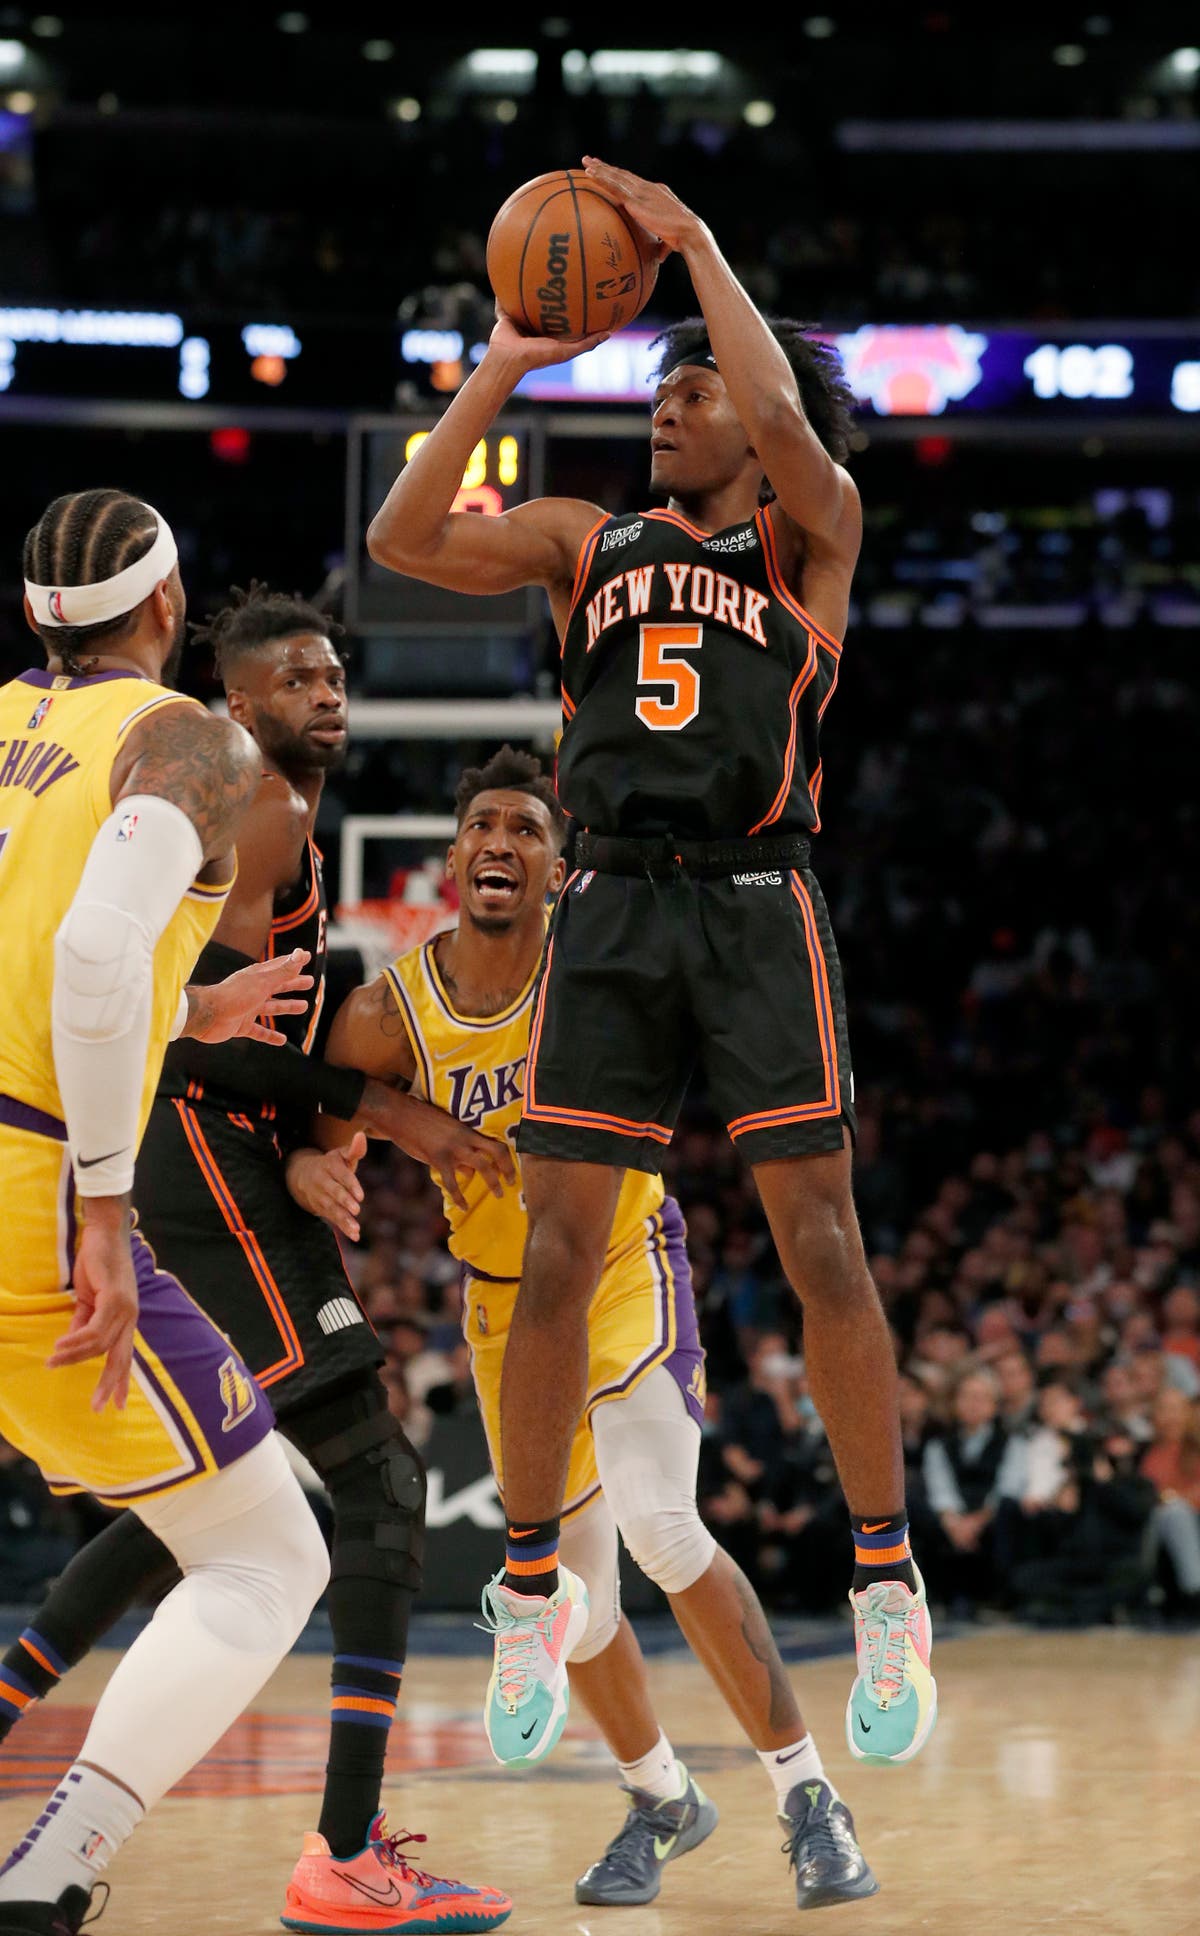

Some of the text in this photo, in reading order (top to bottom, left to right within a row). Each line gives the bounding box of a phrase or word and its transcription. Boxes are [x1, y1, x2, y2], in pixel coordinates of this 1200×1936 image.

[537, 232, 571, 335] Wilson
[702, 528, 753, 549] SQUARE
[586, 563, 769, 653] NEW YORK
[635, 623, 703, 731] 5
[0, 739, 80, 798] HONY
